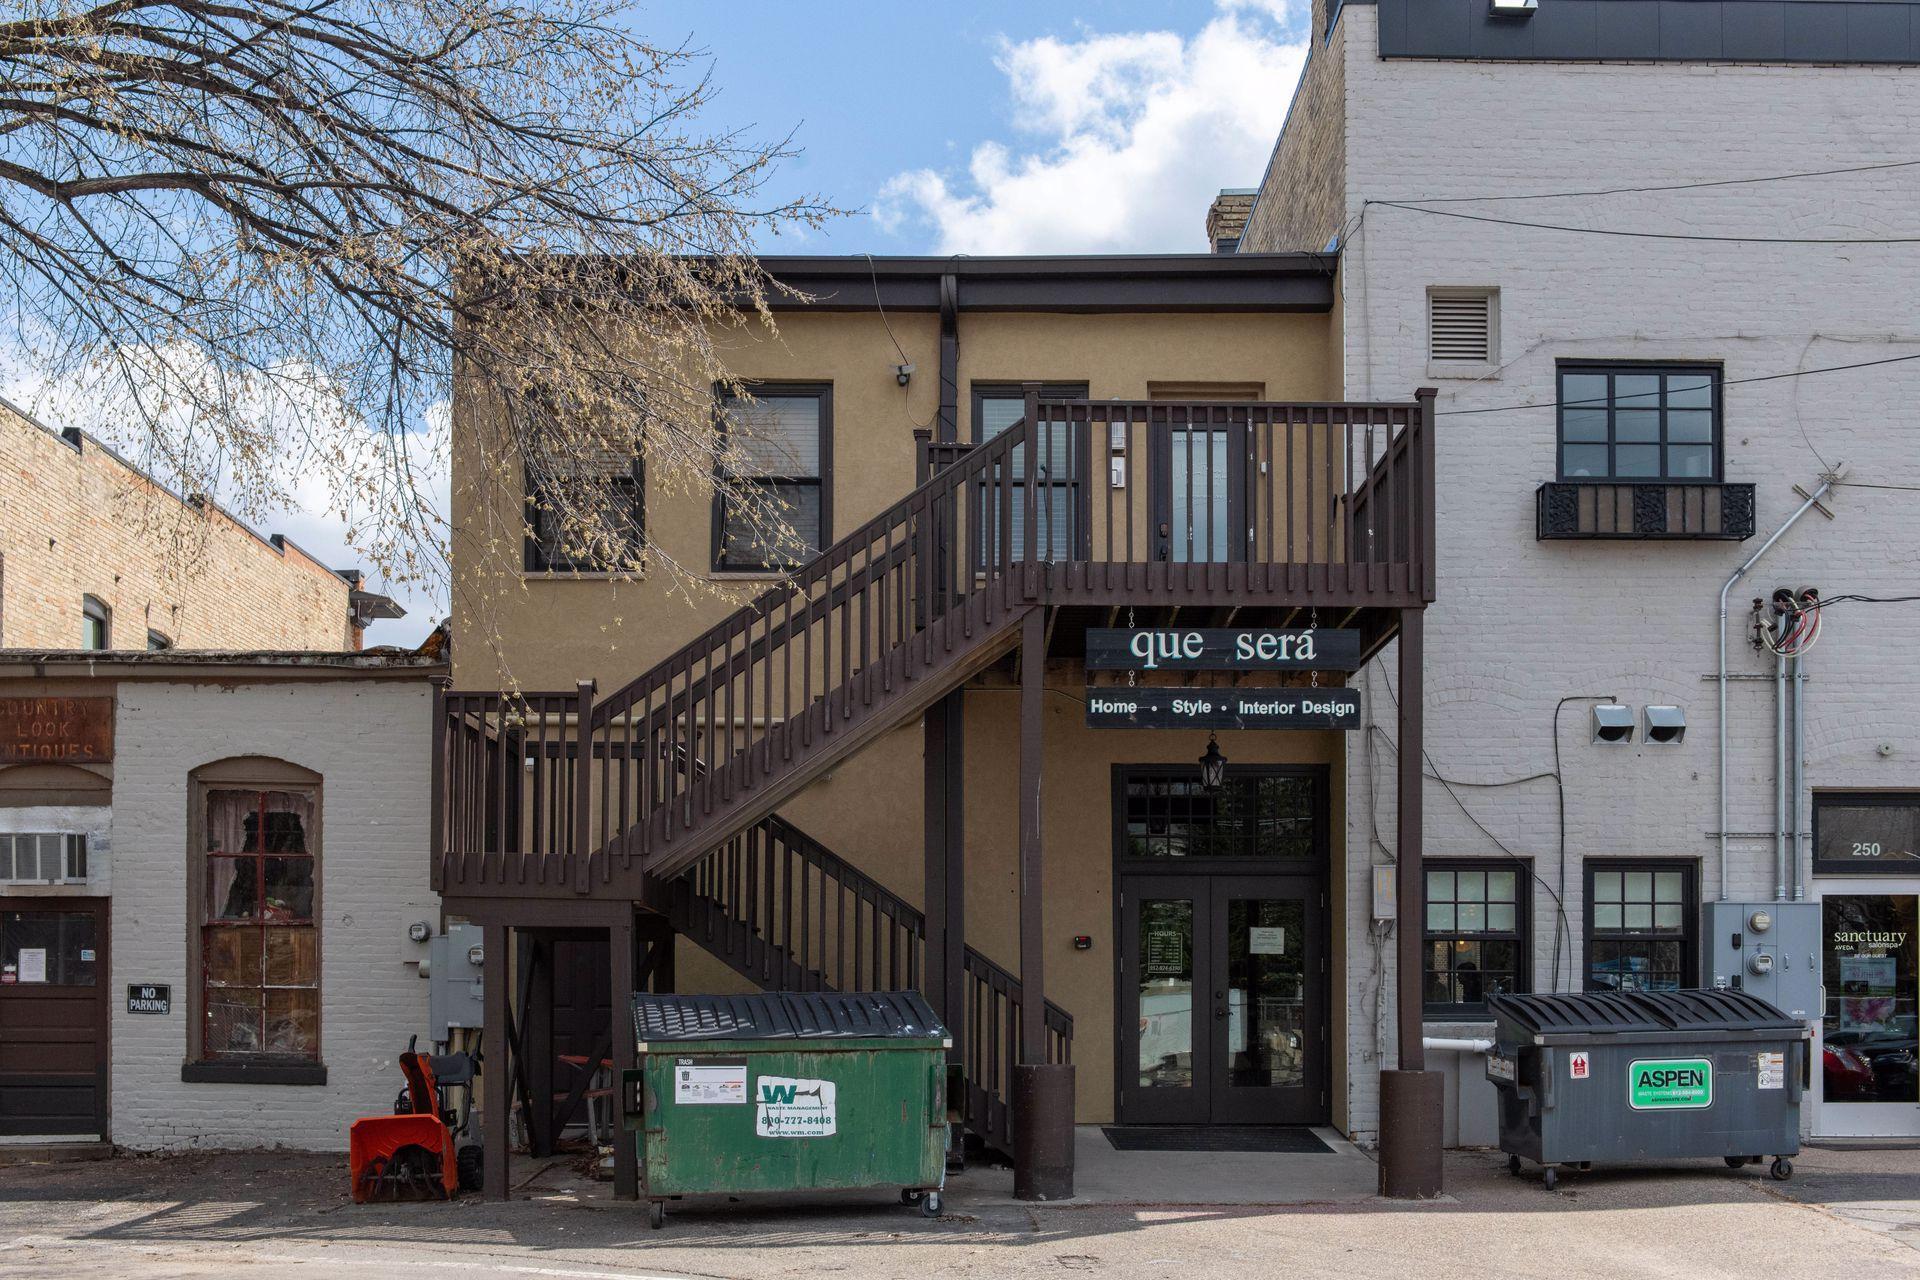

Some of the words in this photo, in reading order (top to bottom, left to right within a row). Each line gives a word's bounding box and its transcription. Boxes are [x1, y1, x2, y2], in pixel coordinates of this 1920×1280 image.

[1130, 631, 1204, 668] que
[1236, 629, 1317, 661] será
[1091, 699, 1137, 714] Home
[1172, 699, 1212, 717] Style
[1239, 700, 1295, 715] Interior
[1302, 700, 1355, 717] Design
[17, 721, 72, 737] LOOK
[1852, 842, 1880, 856] 250
[1834, 930, 1907, 946] sanctuary
[141, 987, 156, 999] NO
[130, 1000, 167, 1011] PARKING
[1638, 1070, 1703, 1088] ASPEN
